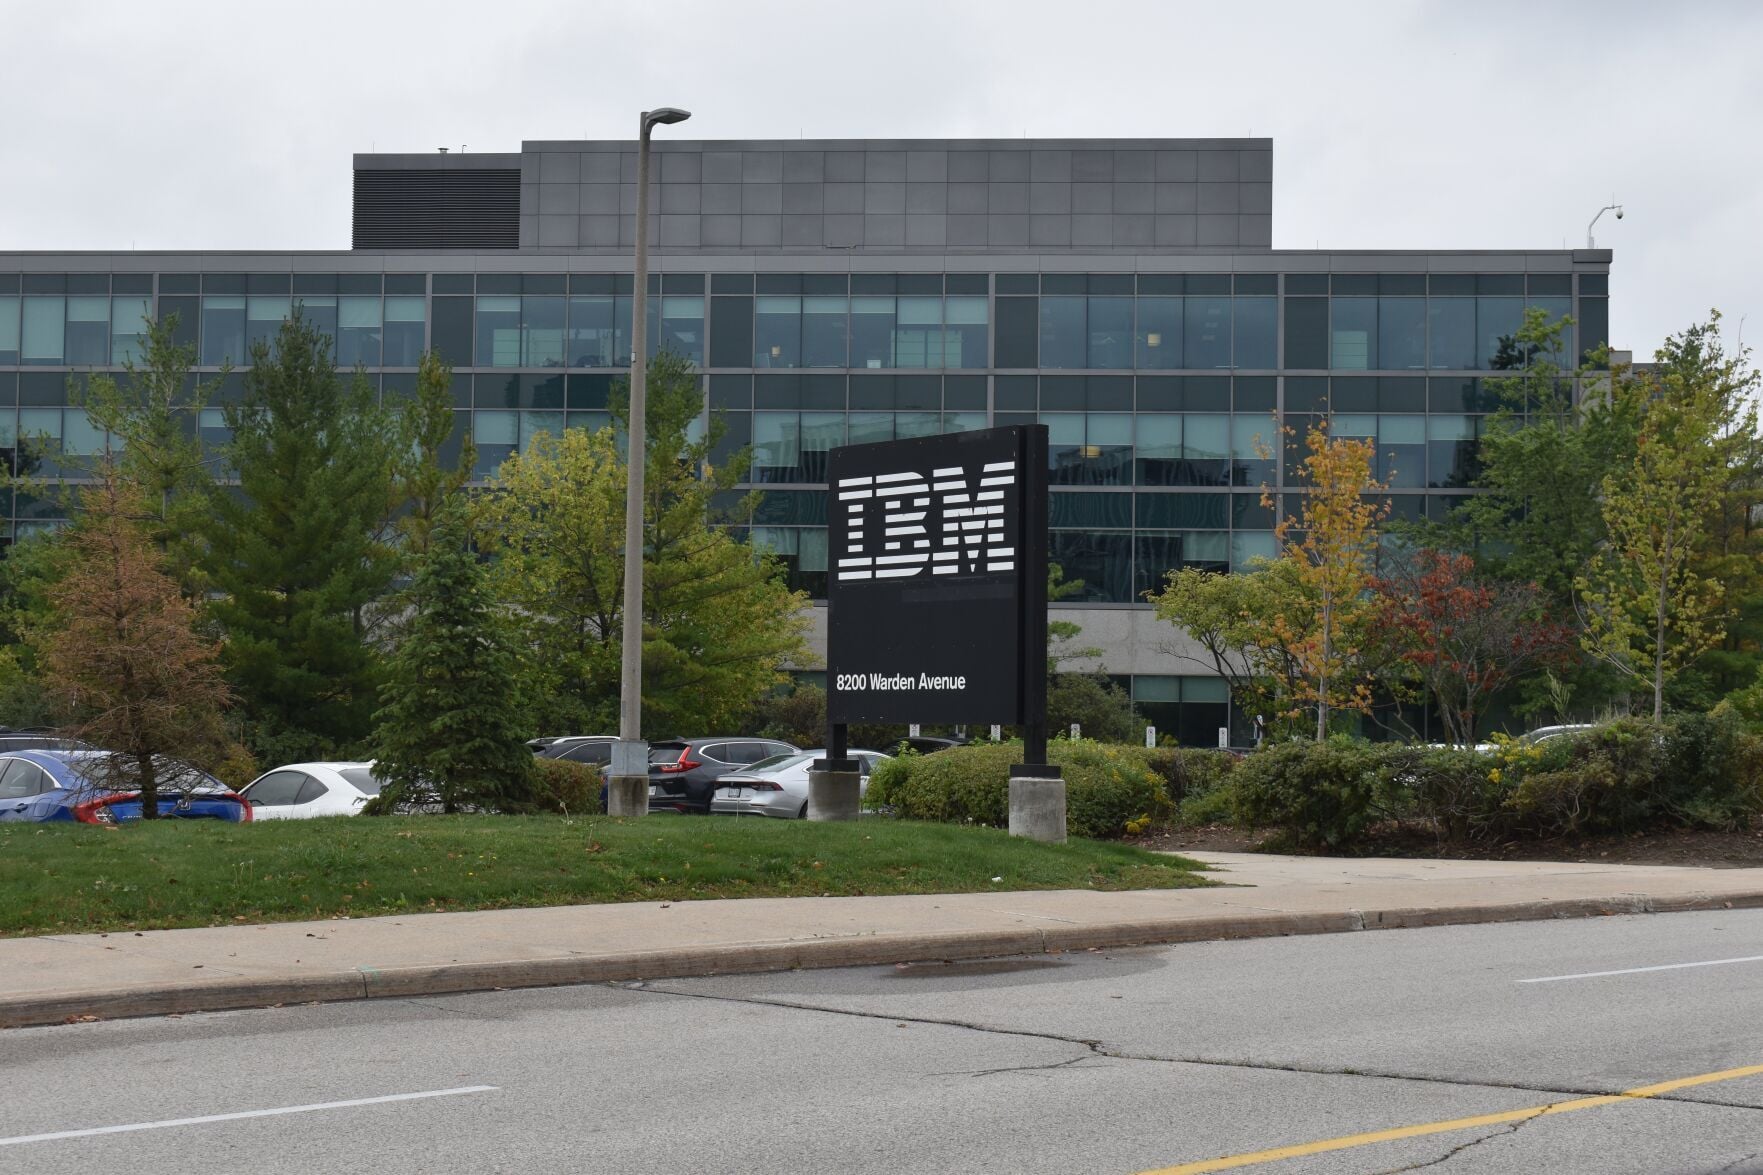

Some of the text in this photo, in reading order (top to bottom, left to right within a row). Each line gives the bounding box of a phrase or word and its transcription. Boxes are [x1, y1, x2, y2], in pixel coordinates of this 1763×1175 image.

[838, 461, 1015, 580] IBM
[836, 673, 966, 690] 8200 Warden Avenue
